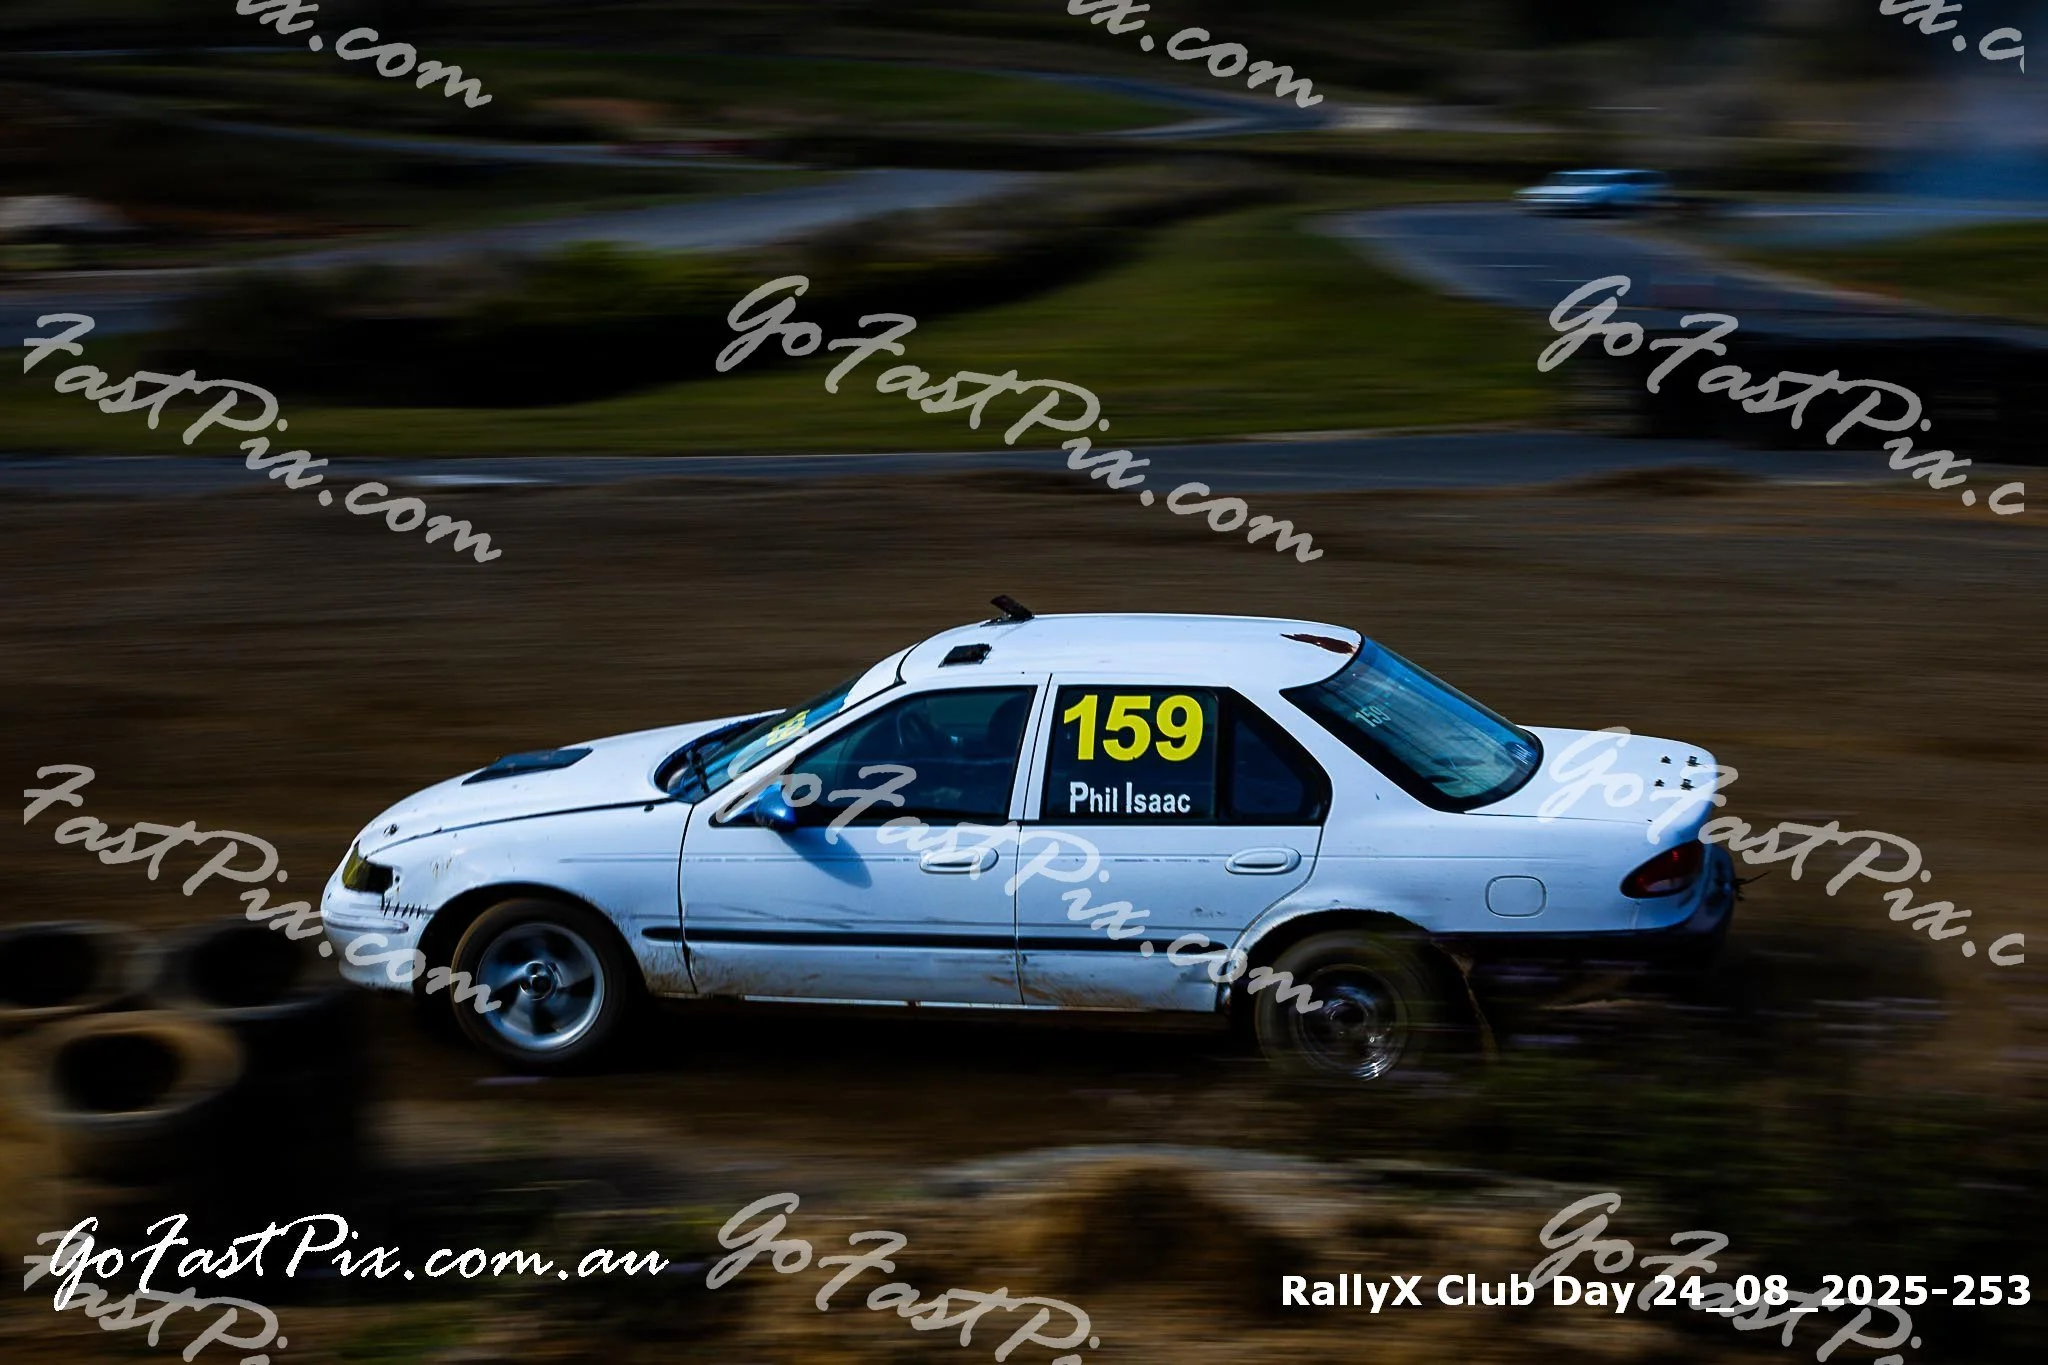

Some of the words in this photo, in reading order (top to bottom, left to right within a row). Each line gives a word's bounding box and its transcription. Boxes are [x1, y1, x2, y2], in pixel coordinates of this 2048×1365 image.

[1063, 694, 1204, 761] 159
[1355, 705, 1391, 727] 159
[1069, 781, 1118, 813] Phil
[1126, 781, 1191, 813] Isaac
